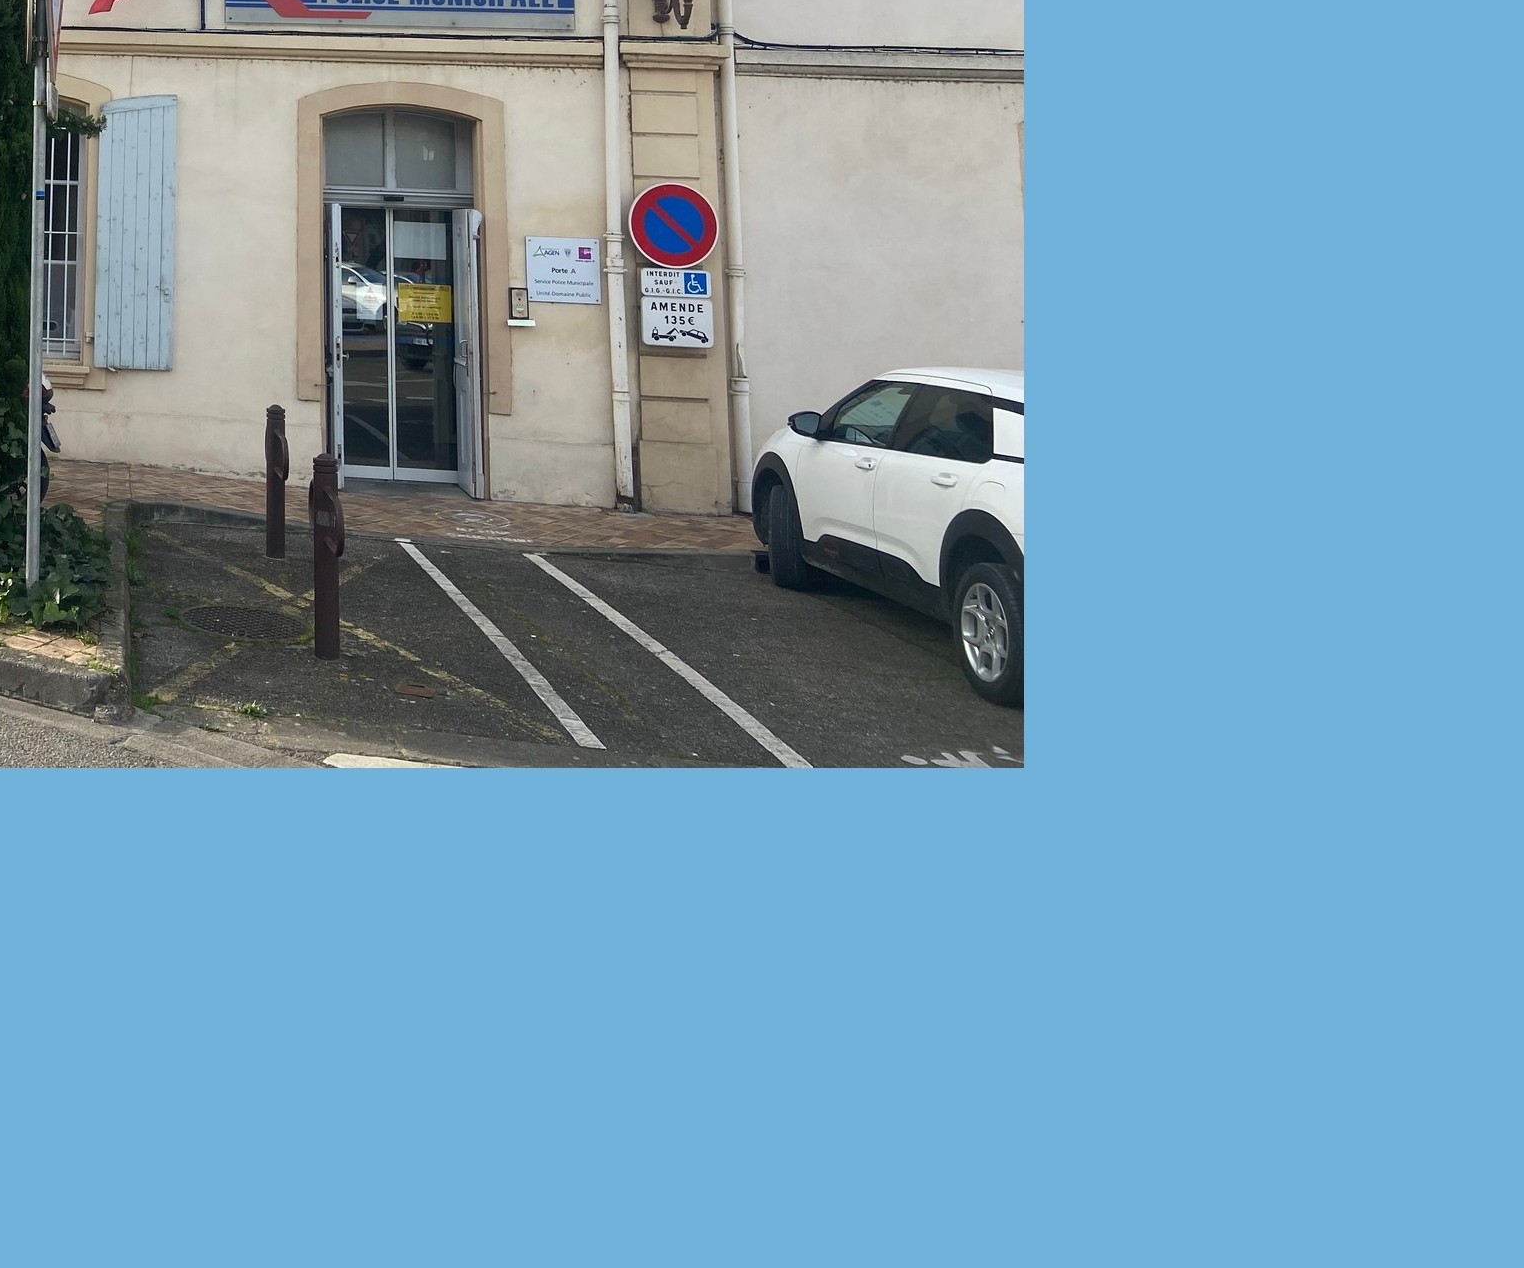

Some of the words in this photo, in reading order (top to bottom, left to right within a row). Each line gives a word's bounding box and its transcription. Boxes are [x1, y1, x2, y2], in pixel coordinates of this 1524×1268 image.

[646, 270, 680, 278] INTERDIT
[650, 302, 704, 313] AMENDE
[664, 315, 695, 326] 135€
